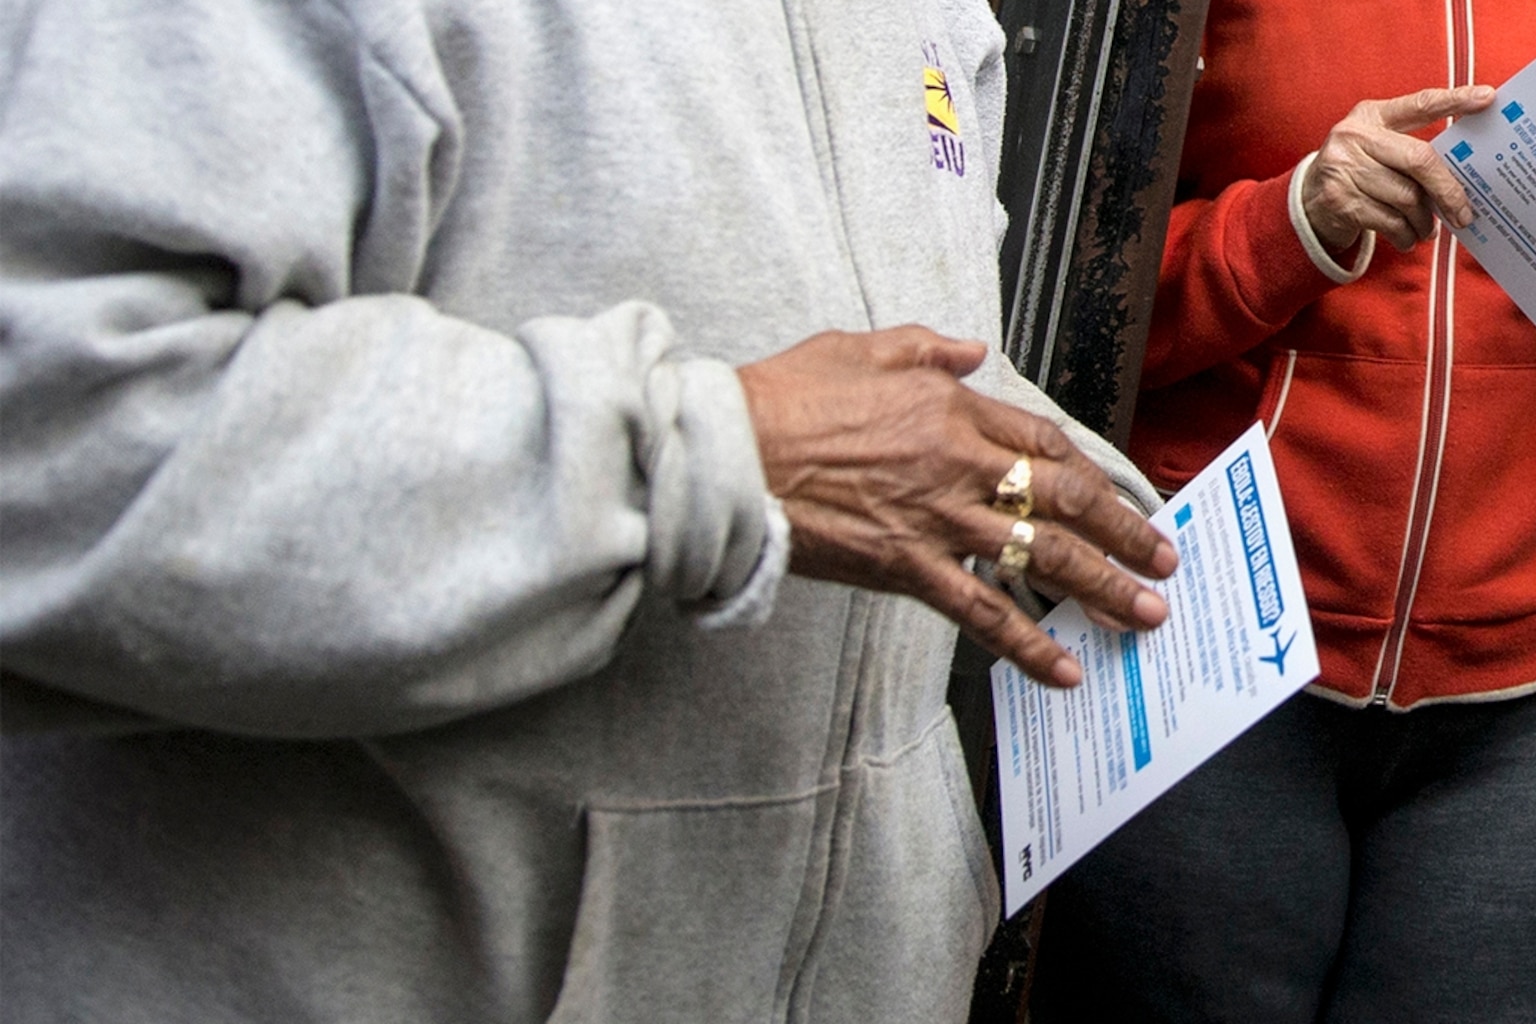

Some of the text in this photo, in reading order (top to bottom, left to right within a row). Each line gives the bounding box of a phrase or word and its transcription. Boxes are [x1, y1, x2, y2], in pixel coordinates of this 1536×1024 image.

[930, 133, 965, 177] EIU
[1249, 545, 1269, 573] EN
[1021, 843, 1032, 882] NYC
